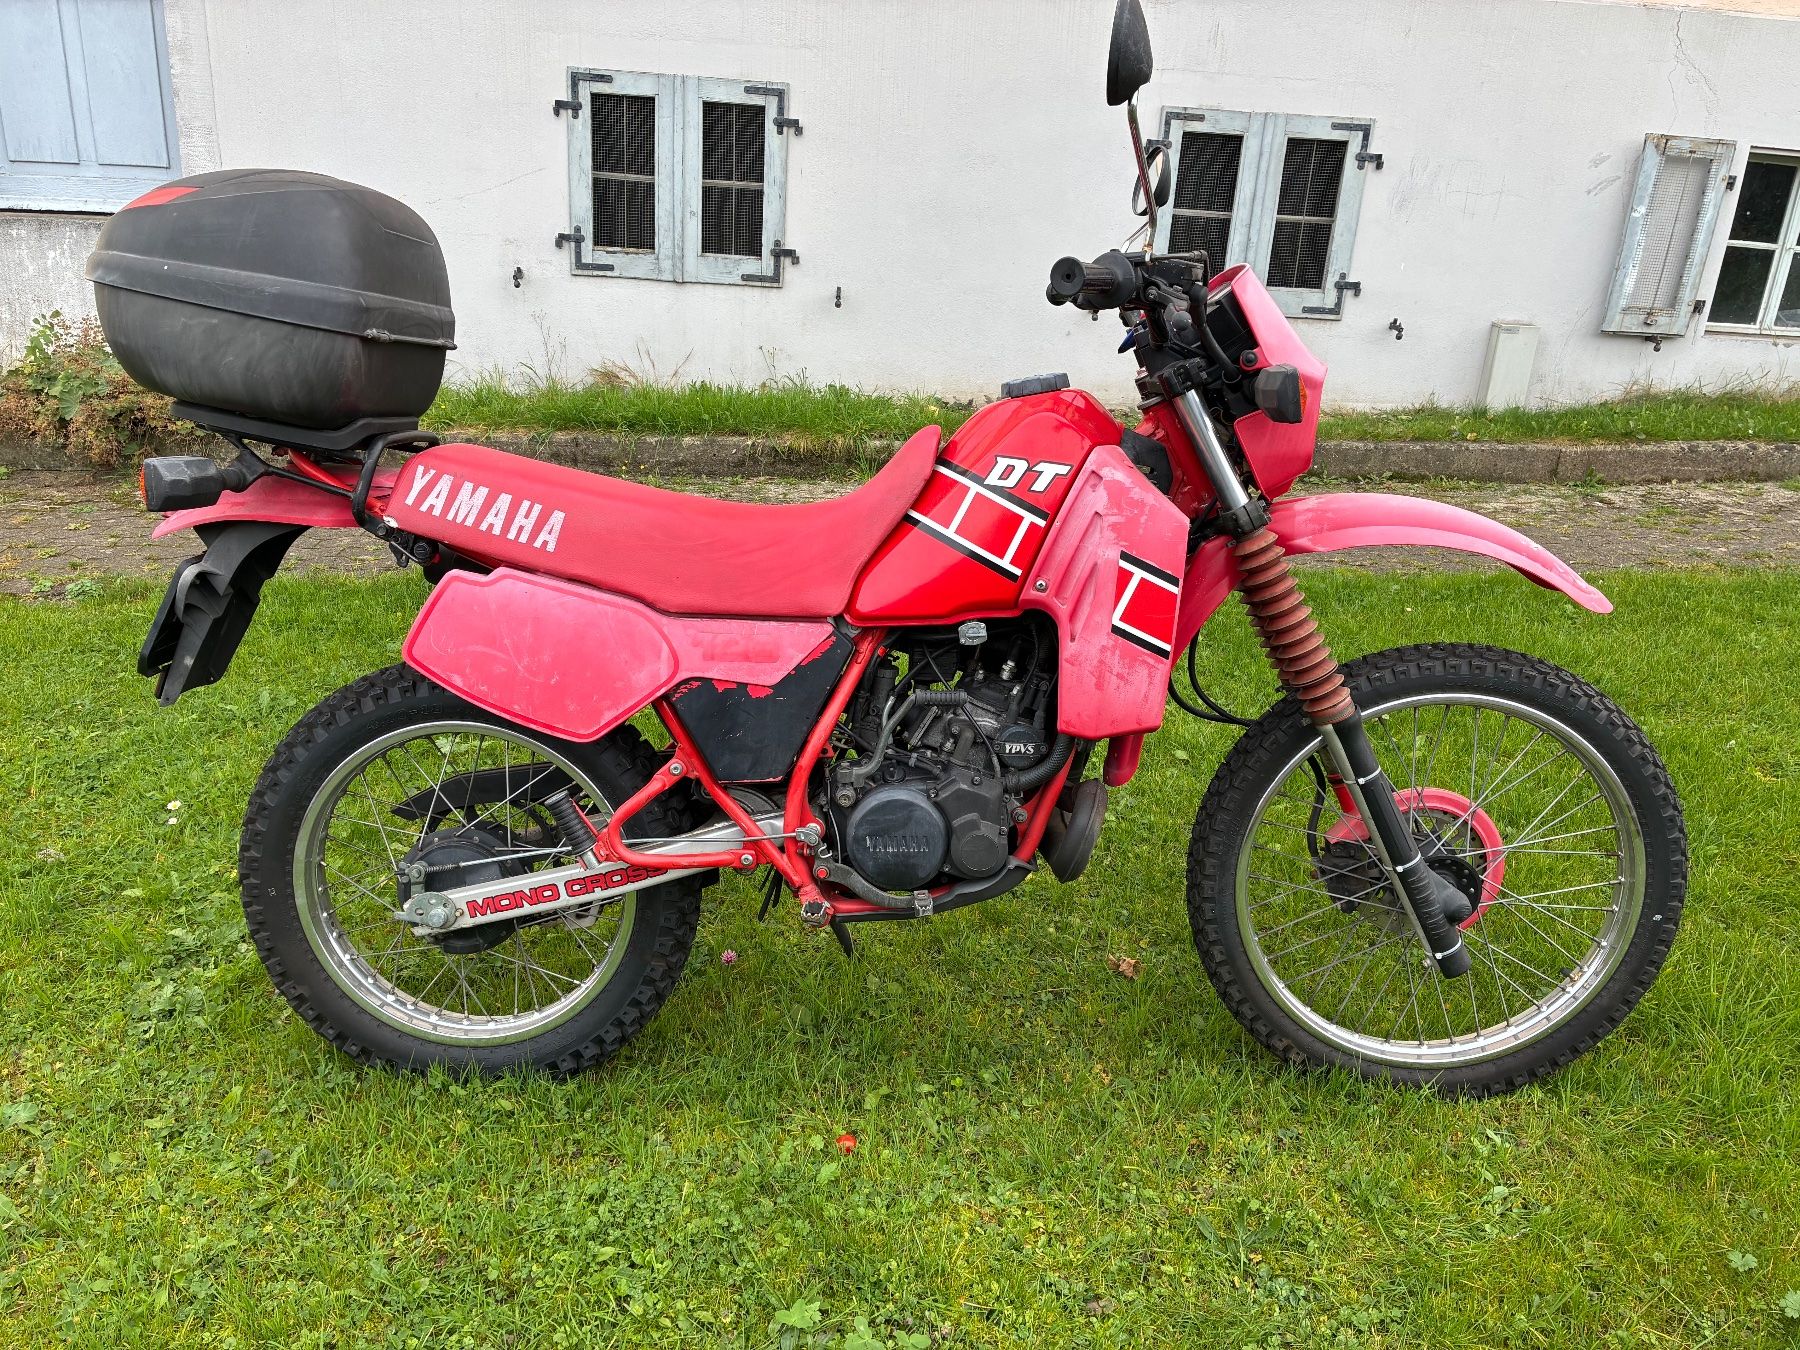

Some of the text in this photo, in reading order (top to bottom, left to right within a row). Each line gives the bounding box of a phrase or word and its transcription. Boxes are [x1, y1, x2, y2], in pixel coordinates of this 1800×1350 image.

[983, 456, 1073, 494] DT
[405, 465, 566, 552] YAMAHA
[1005, 743, 1035, 754] YPVS
[466, 883, 560, 918] MONO
